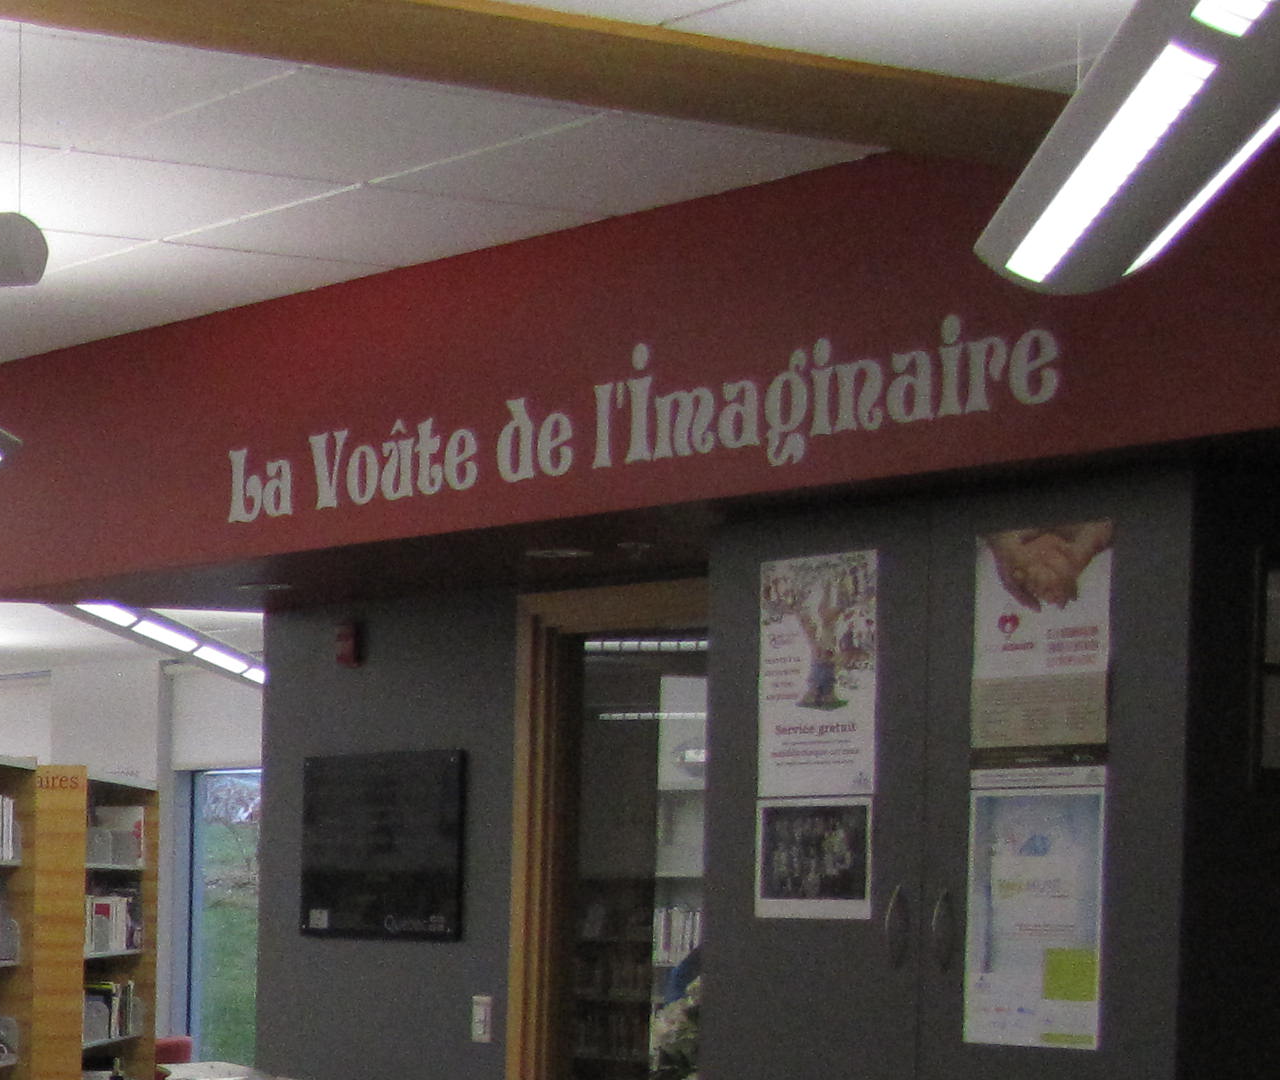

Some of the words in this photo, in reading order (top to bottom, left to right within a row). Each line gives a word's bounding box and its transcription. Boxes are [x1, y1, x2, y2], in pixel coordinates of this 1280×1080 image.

[228, 448, 292, 523] La
[309, 418, 478, 511] Voûte
[496, 398, 573, 485] de
[593, 313, 1061, 468] l'Imaginaire
